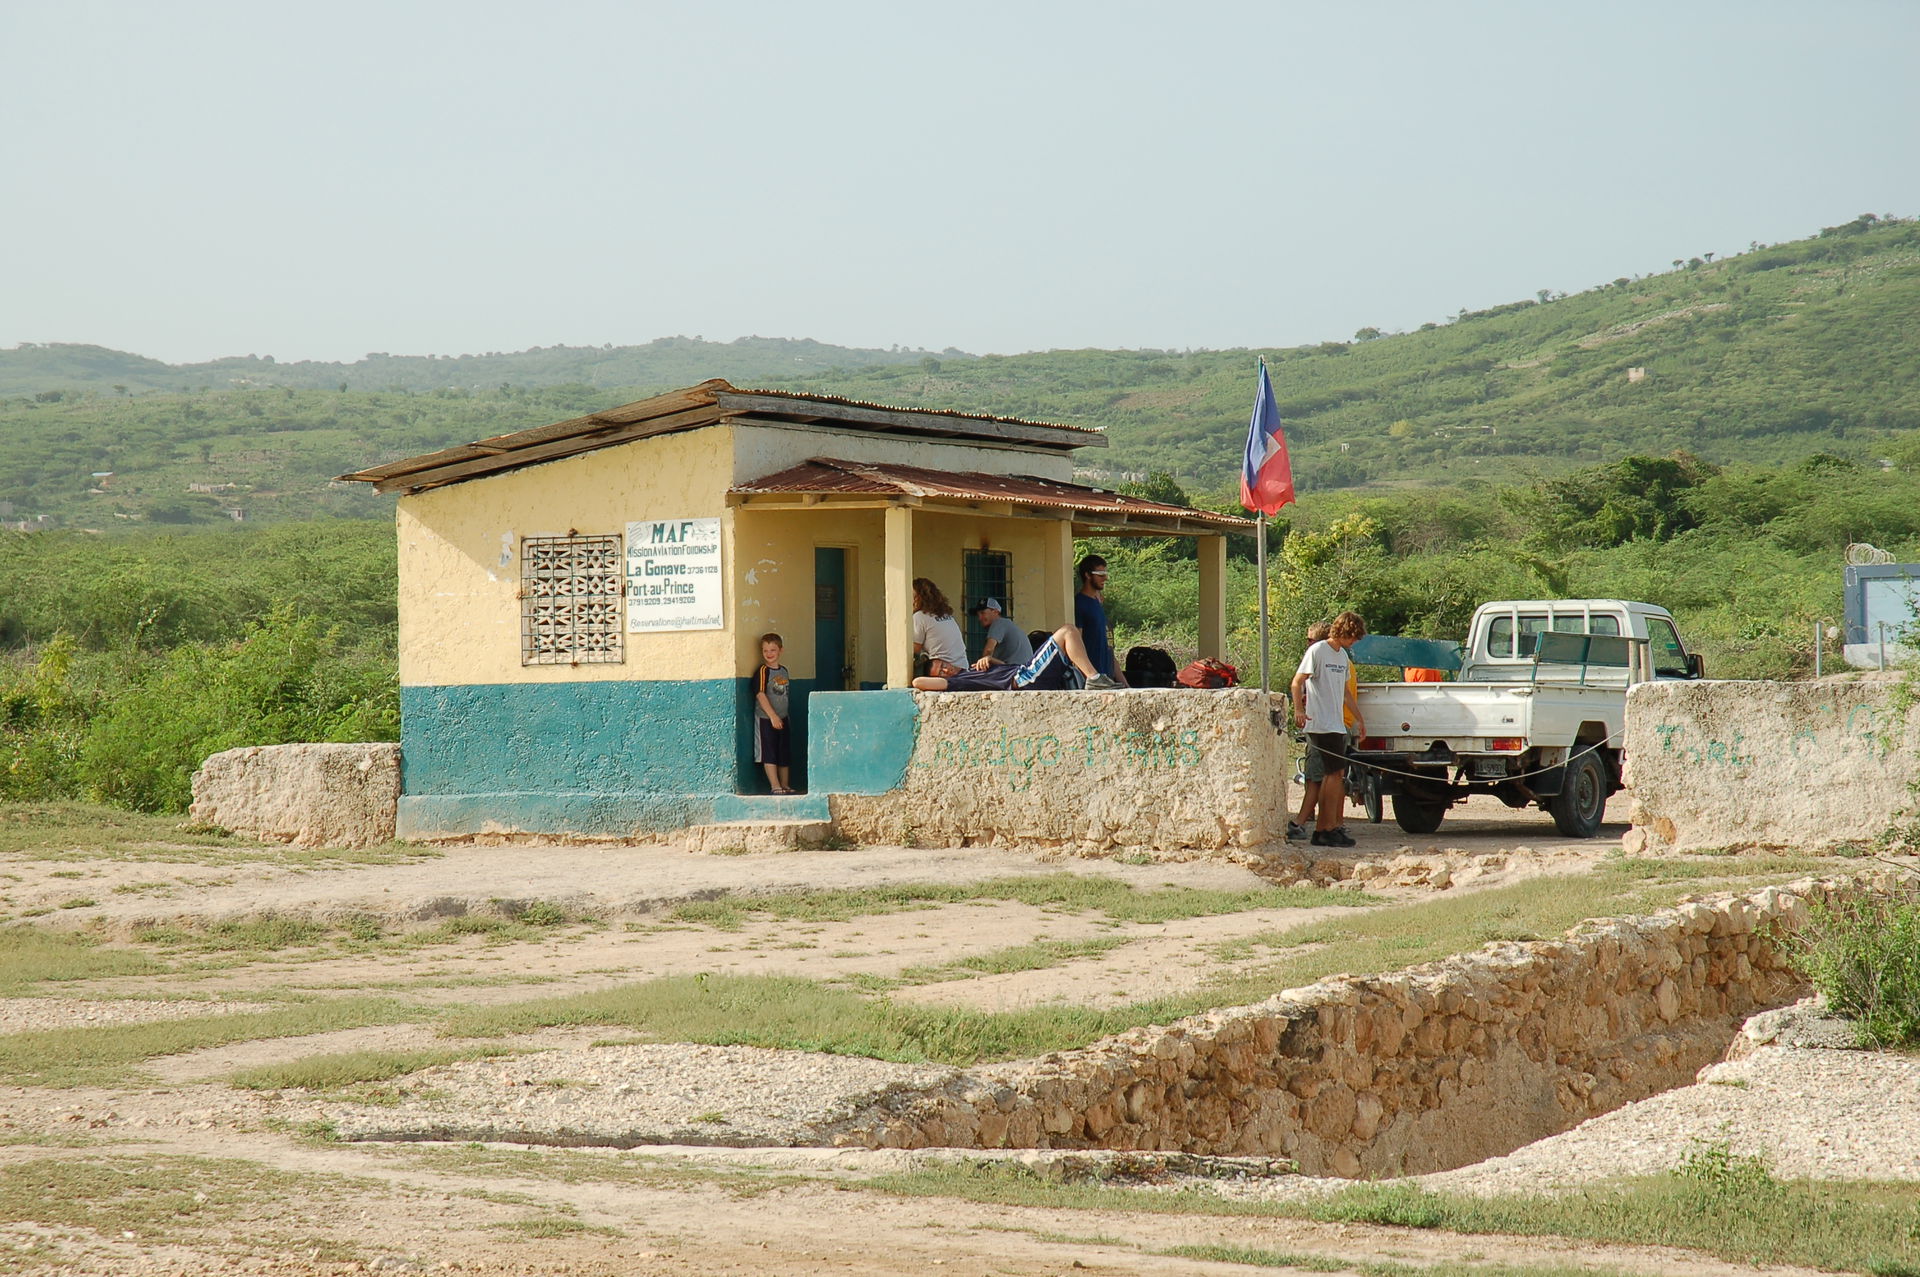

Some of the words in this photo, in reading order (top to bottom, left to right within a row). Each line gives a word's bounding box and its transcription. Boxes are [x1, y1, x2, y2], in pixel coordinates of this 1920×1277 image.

[651, 522, 693, 543] MAF
[626, 560, 642, 577] La
[645, 559, 686, 576] Gonave
